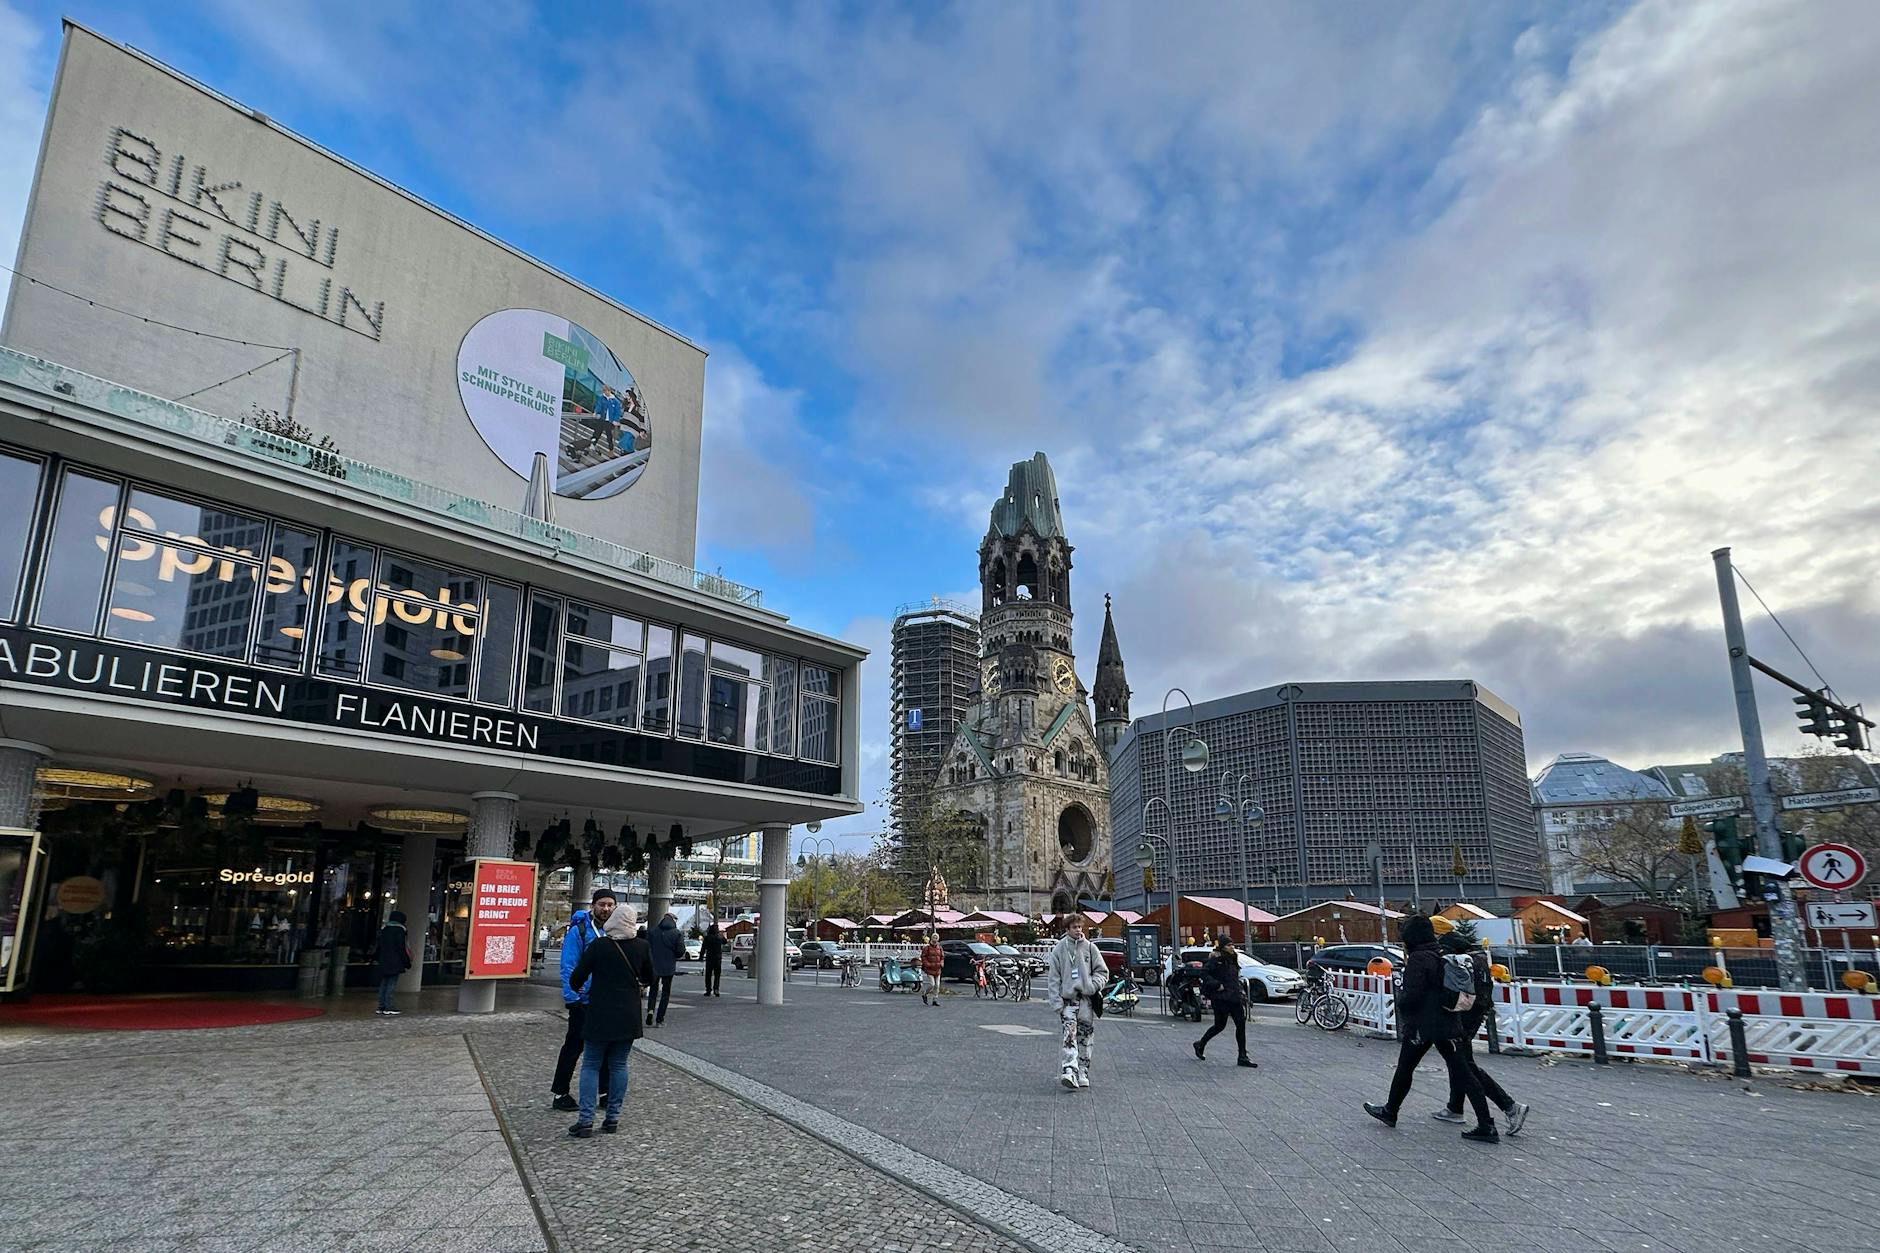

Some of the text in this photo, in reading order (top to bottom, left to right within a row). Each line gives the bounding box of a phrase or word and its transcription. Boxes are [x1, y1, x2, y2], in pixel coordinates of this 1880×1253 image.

[103, 125, 339, 269] BIKINI
[91, 180, 385, 341] BERLIN
[462, 371, 555, 416] SCHNUPPERKURS
[477, 365, 557, 405] MIT STYLE AUF
[335, 693, 539, 750] FLANIEREN
[909, 708, 920, 723] T
[1674, 803, 1714, 814] Budapester
[479, 897, 528, 907] DER FREUDE
[481, 884, 496, 893] EIN
[478, 910, 509, 919] BRINGT
